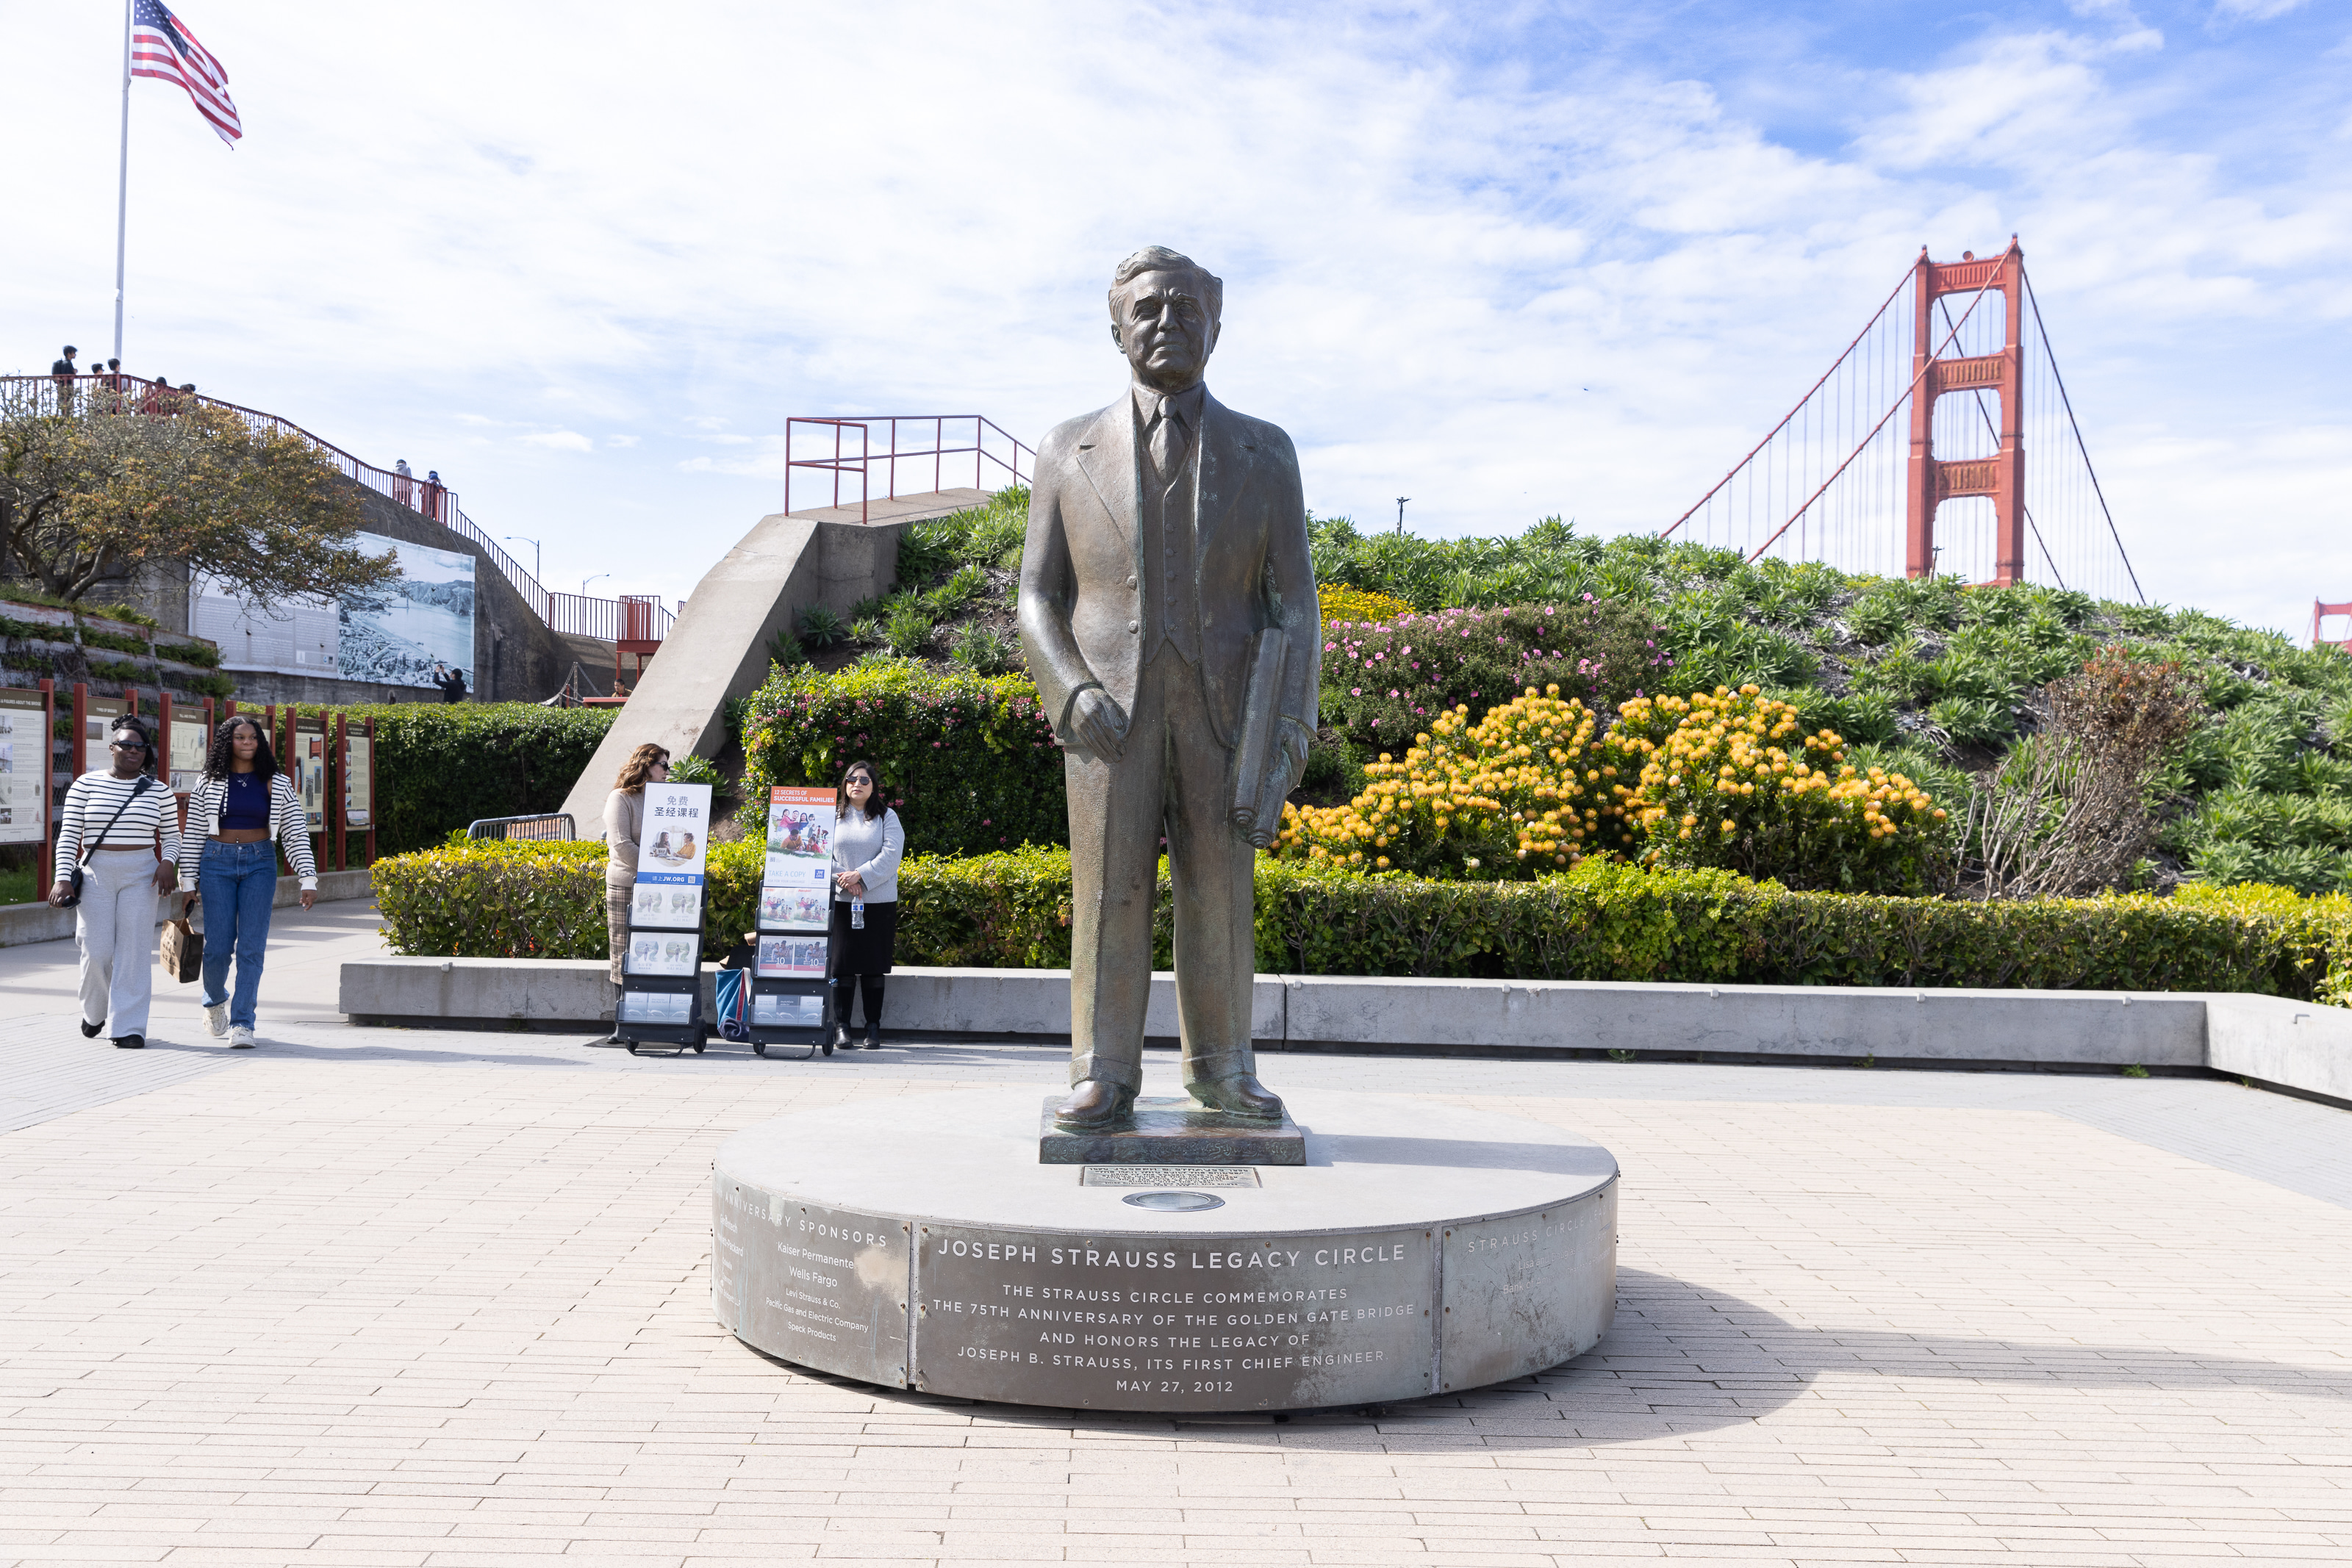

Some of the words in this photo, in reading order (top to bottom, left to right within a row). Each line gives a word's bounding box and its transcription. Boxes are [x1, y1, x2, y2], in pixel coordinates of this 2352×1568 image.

[667, 795, 689, 806] 免费
[654, 807, 699, 818] 圣经课程
[776, 957, 785, 965] 10
[810, 958, 819, 966] 10
[725, 1191, 792, 1227] ANNIVERSARY
[799, 1220, 886, 1247] SPONSORS
[1468, 1229, 1538, 1253] STRAUSS
[1546, 1218, 1585, 1237] CIRCLE
[778, 1241, 800, 1256] Kaiser
[802, 1248, 854, 1270] Permanente
[938, 1239, 1036, 1263] JOSEPH
[1051, 1248, 1176, 1269] STRAUSS
[1192, 1251, 1300, 1269] LEGACY
[1315, 1244, 1404, 1266] CIRCLE
[1519, 1259, 1534, 1271] Lisa
[1536, 1254, 1549, 1267] and
[789, 1265, 810, 1281] Wells
[812, 1272, 838, 1287] Fargo
[1503, 1281, 1524, 1294] Bank
[1526, 1279, 1534, 1290] of
[786, 1287, 798, 1298] Levi
[799, 1291, 822, 1304] Strauss
[822, 1298, 828, 1306] &
[829, 1299, 841, 1309] Co.
[1003, 1284, 1033, 1298] THE
[1042, 1287, 1121, 1302] STRAUSS
[1130, 1291, 1194, 1304] CIRCLE
[1203, 1288, 1347, 1304] COMMEMORATES
[766, 1297, 783, 1310] Pacific
[784, 1303, 795, 1314] Gas
[795, 1308, 807, 1317] and
[808, 1310, 833, 1324] Electric
[834, 1317, 869, 1333] Company
[933, 1299, 962, 1313] THE
[970, 1303, 1009, 1317] 75TH
[1018, 1308, 1144, 1325] ANNIVERSARY
[1152, 1315, 1175, 1326] OF
[1185, 1315, 1218, 1326] THE
[1227, 1312, 1298, 1326] GOLDEN
[1307, 1310, 1349, 1323] GATE
[1357, 1303, 1414, 1320] BRIDGE
[788, 1321, 806, 1334] Speck
[807, 1327, 836, 1342] Products
[1039, 1331, 1075, 1344] AND
[1084, 1334, 1159, 1348] HONORS
[1168, 1337, 1201, 1348] THE
[1211, 1335, 1280, 1348] LEGACY
[1288, 1334, 1310, 1345] OF
[957, 1346, 1019, 1362] JOSEPH
[1029, 1353, 1044, 1364] B.
[1053, 1354, 1138, 1371] STRAUSS,
[1147, 1359, 1173, 1370] ITS
[1183, 1359, 1233, 1370] FIRST
[1241, 1357, 1293, 1370] CHIEF
[1116, 1380, 1152, 1392] MAY
[1161, 1381, 1185, 1394] 27,
[1194, 1381, 1233, 1392] 2012
